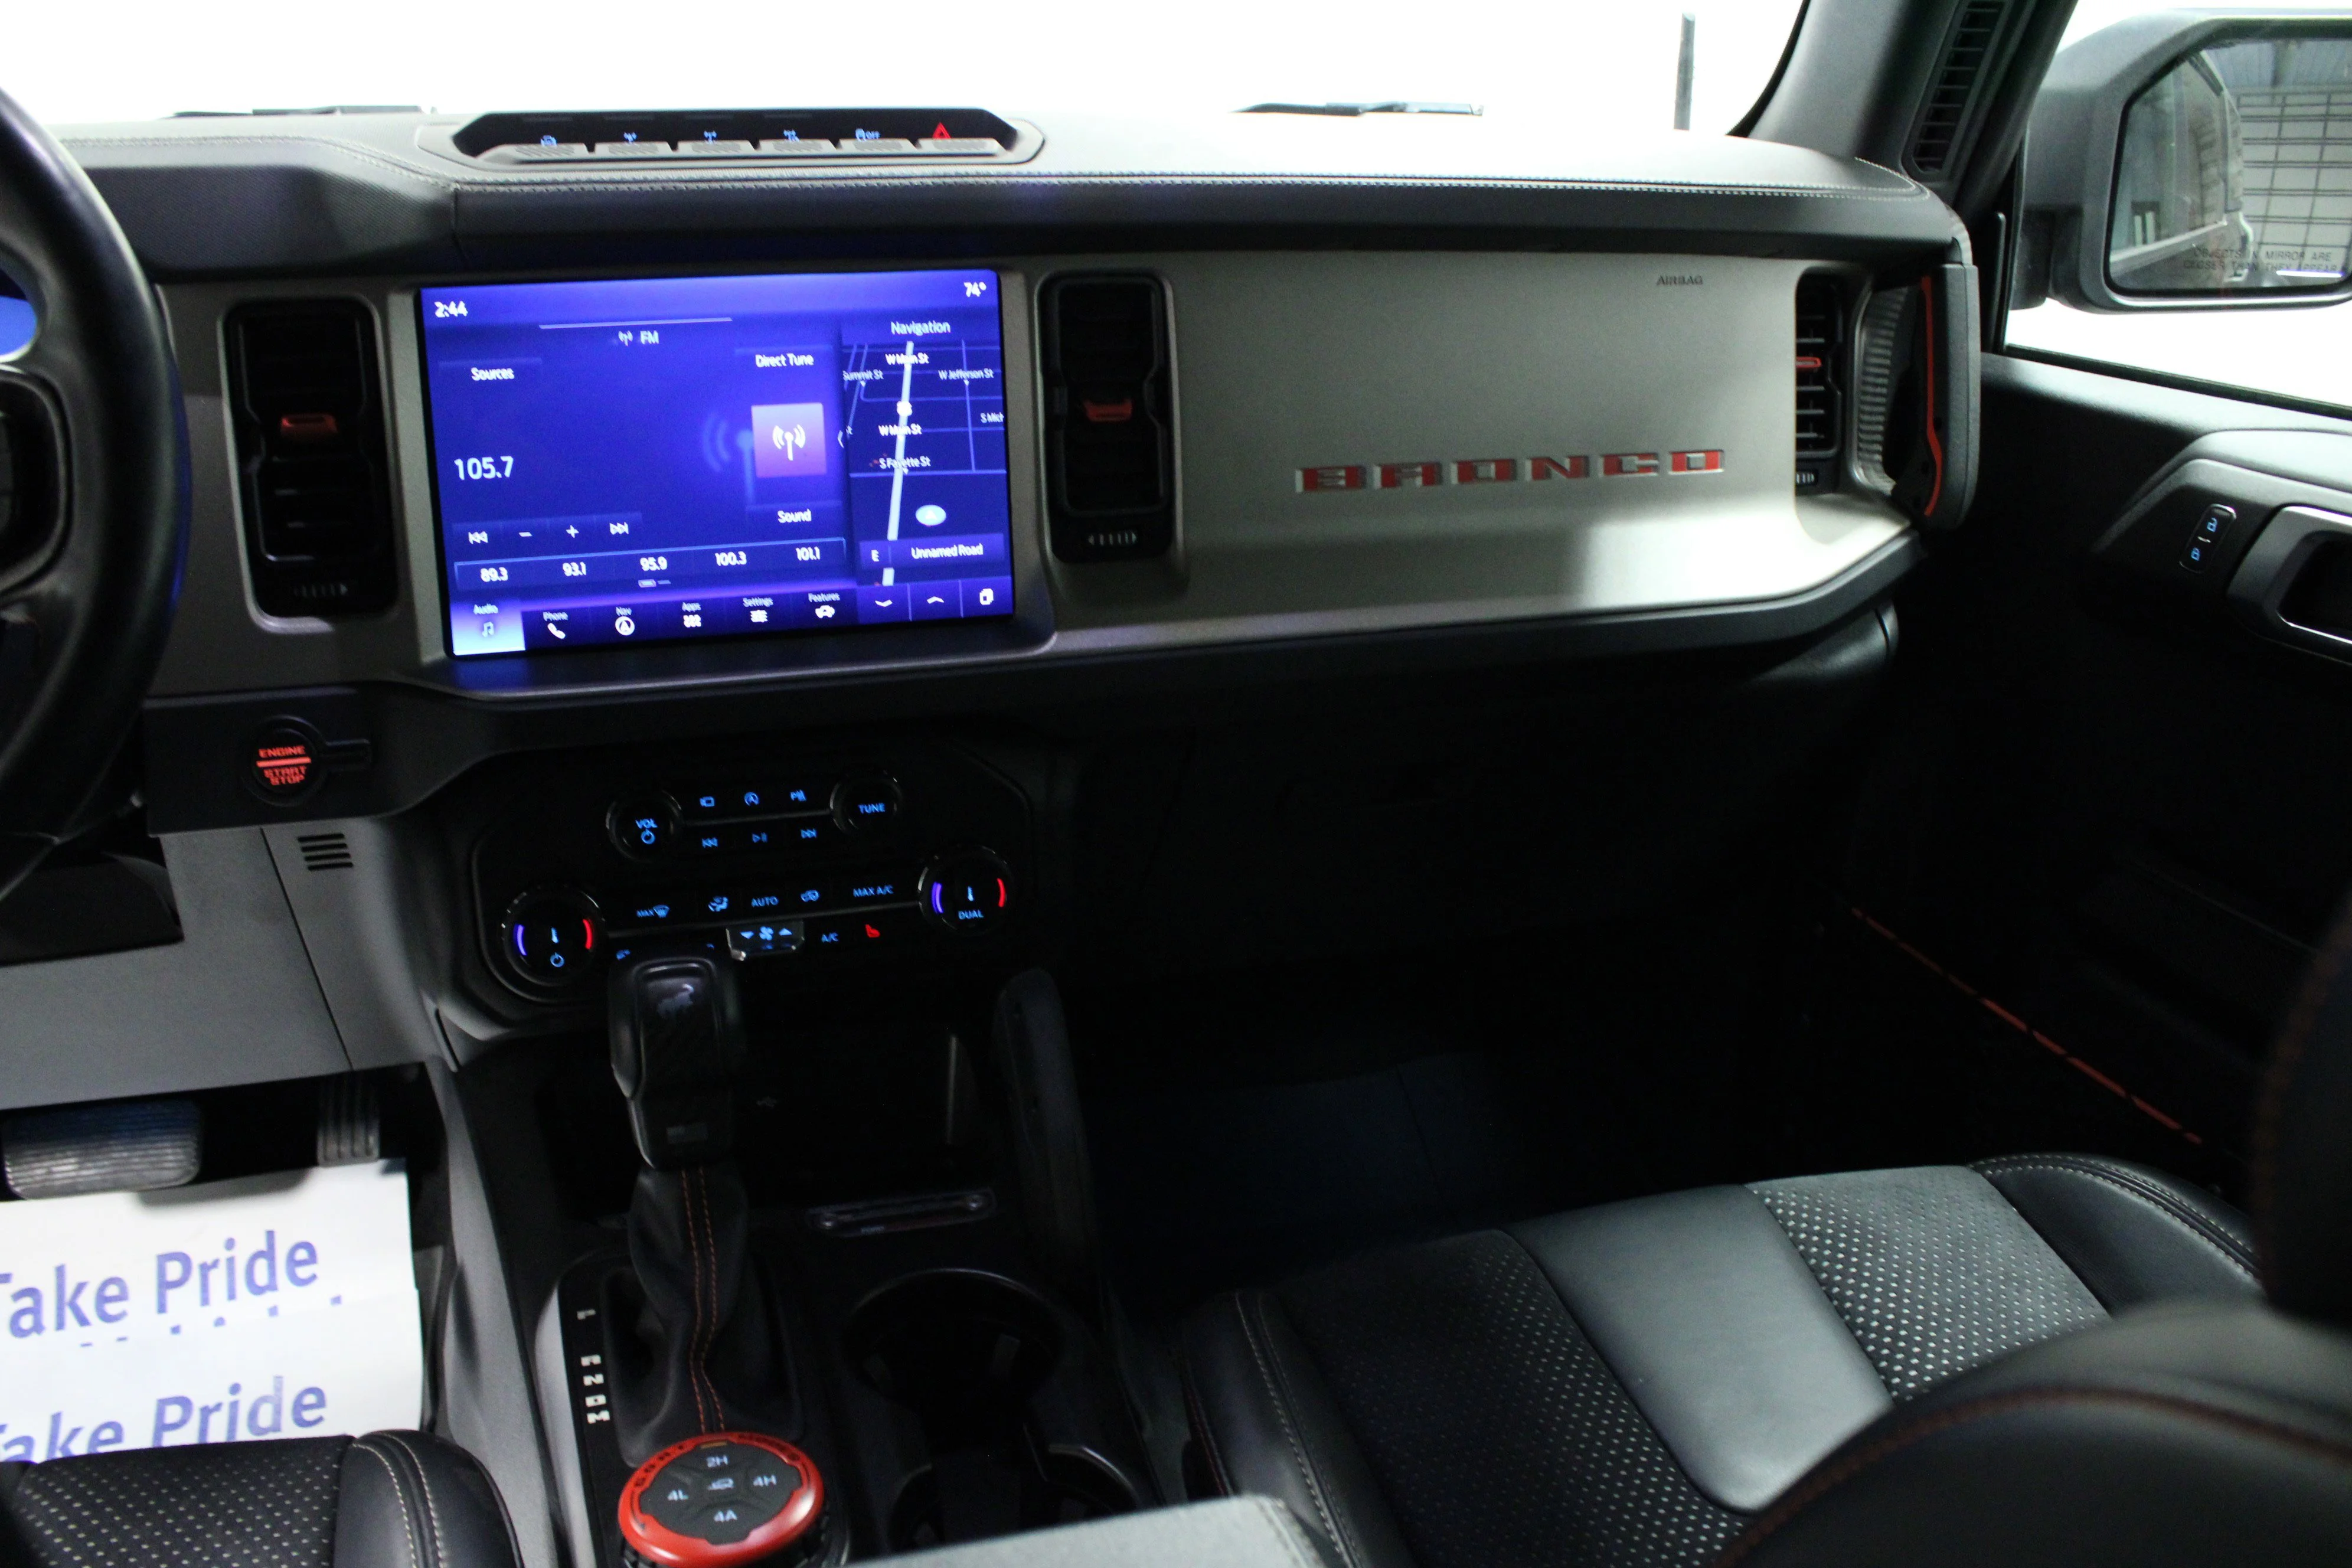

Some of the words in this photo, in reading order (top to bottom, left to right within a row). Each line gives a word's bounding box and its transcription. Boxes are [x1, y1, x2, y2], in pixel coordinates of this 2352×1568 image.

[2266, 250, 2306, 262] MIRROR
[2312, 251, 2332, 262] ARE
[1656, 275, 1704, 286] AIRBAG
[435, 300, 469, 318] 2:44
[890, 321, 952, 336] Navigation
[640, 330, 659, 345] FM
[755, 353, 786, 368] Direct
[788, 352, 815, 367] Tune
[917, 352, 929, 364] St
[471, 367, 515, 381] Sources
[873, 368, 884, 380] St
[937, 370, 948, 380] W
[984, 368, 994, 378] St
[910, 423, 923, 435] St
[919, 455, 932, 467] St
[454, 455, 514, 481] 105.7
[1296, 449, 1724, 493] BRONCO
[778, 508, 812, 524] Sound
[795, 545, 821, 561] 101.1
[871, 549, 880, 562] E
[911, 545, 957, 560] Unnamed
[958, 543, 984, 557] Road
[639, 556, 668, 571] 95.9
[714, 550, 747, 567] 100.3
[480, 566, 509, 583] 89.3
[562, 561, 587, 577] 93.1
[742, 597, 774, 607] Settings
[808, 592, 841, 603] Features
[473, 603, 499, 615] Audio
[615, 606, 632, 616] Nav
[681, 602, 701, 612] Apps
[543, 611, 569, 621] Phone
[258, 745, 305, 759] ENGINE
[263, 766, 307, 779] START
[270, 775, 305, 786] STOP
[858, 802, 886, 814] TUNE
[635, 818, 658, 829] VOL
[853, 887, 875, 897] MAX
[876, 884, 894, 896] A/C
[751, 896, 779, 907] AUTO
[958, 909, 984, 920] DUAL
[821, 932, 839, 943] A/C
[0, 1264, 129, 1338] ake
[156, 1230, 318, 1315] Pride
[582, 1373, 605, 1387] N
[152, 1376, 327, 1448] Pride
[705, 1453, 730, 1468] 2H
[752, 1474, 778, 1487] 4H
[667, 1488, 690, 1501] 4L
[713, 1508, 738, 1523] 4A
